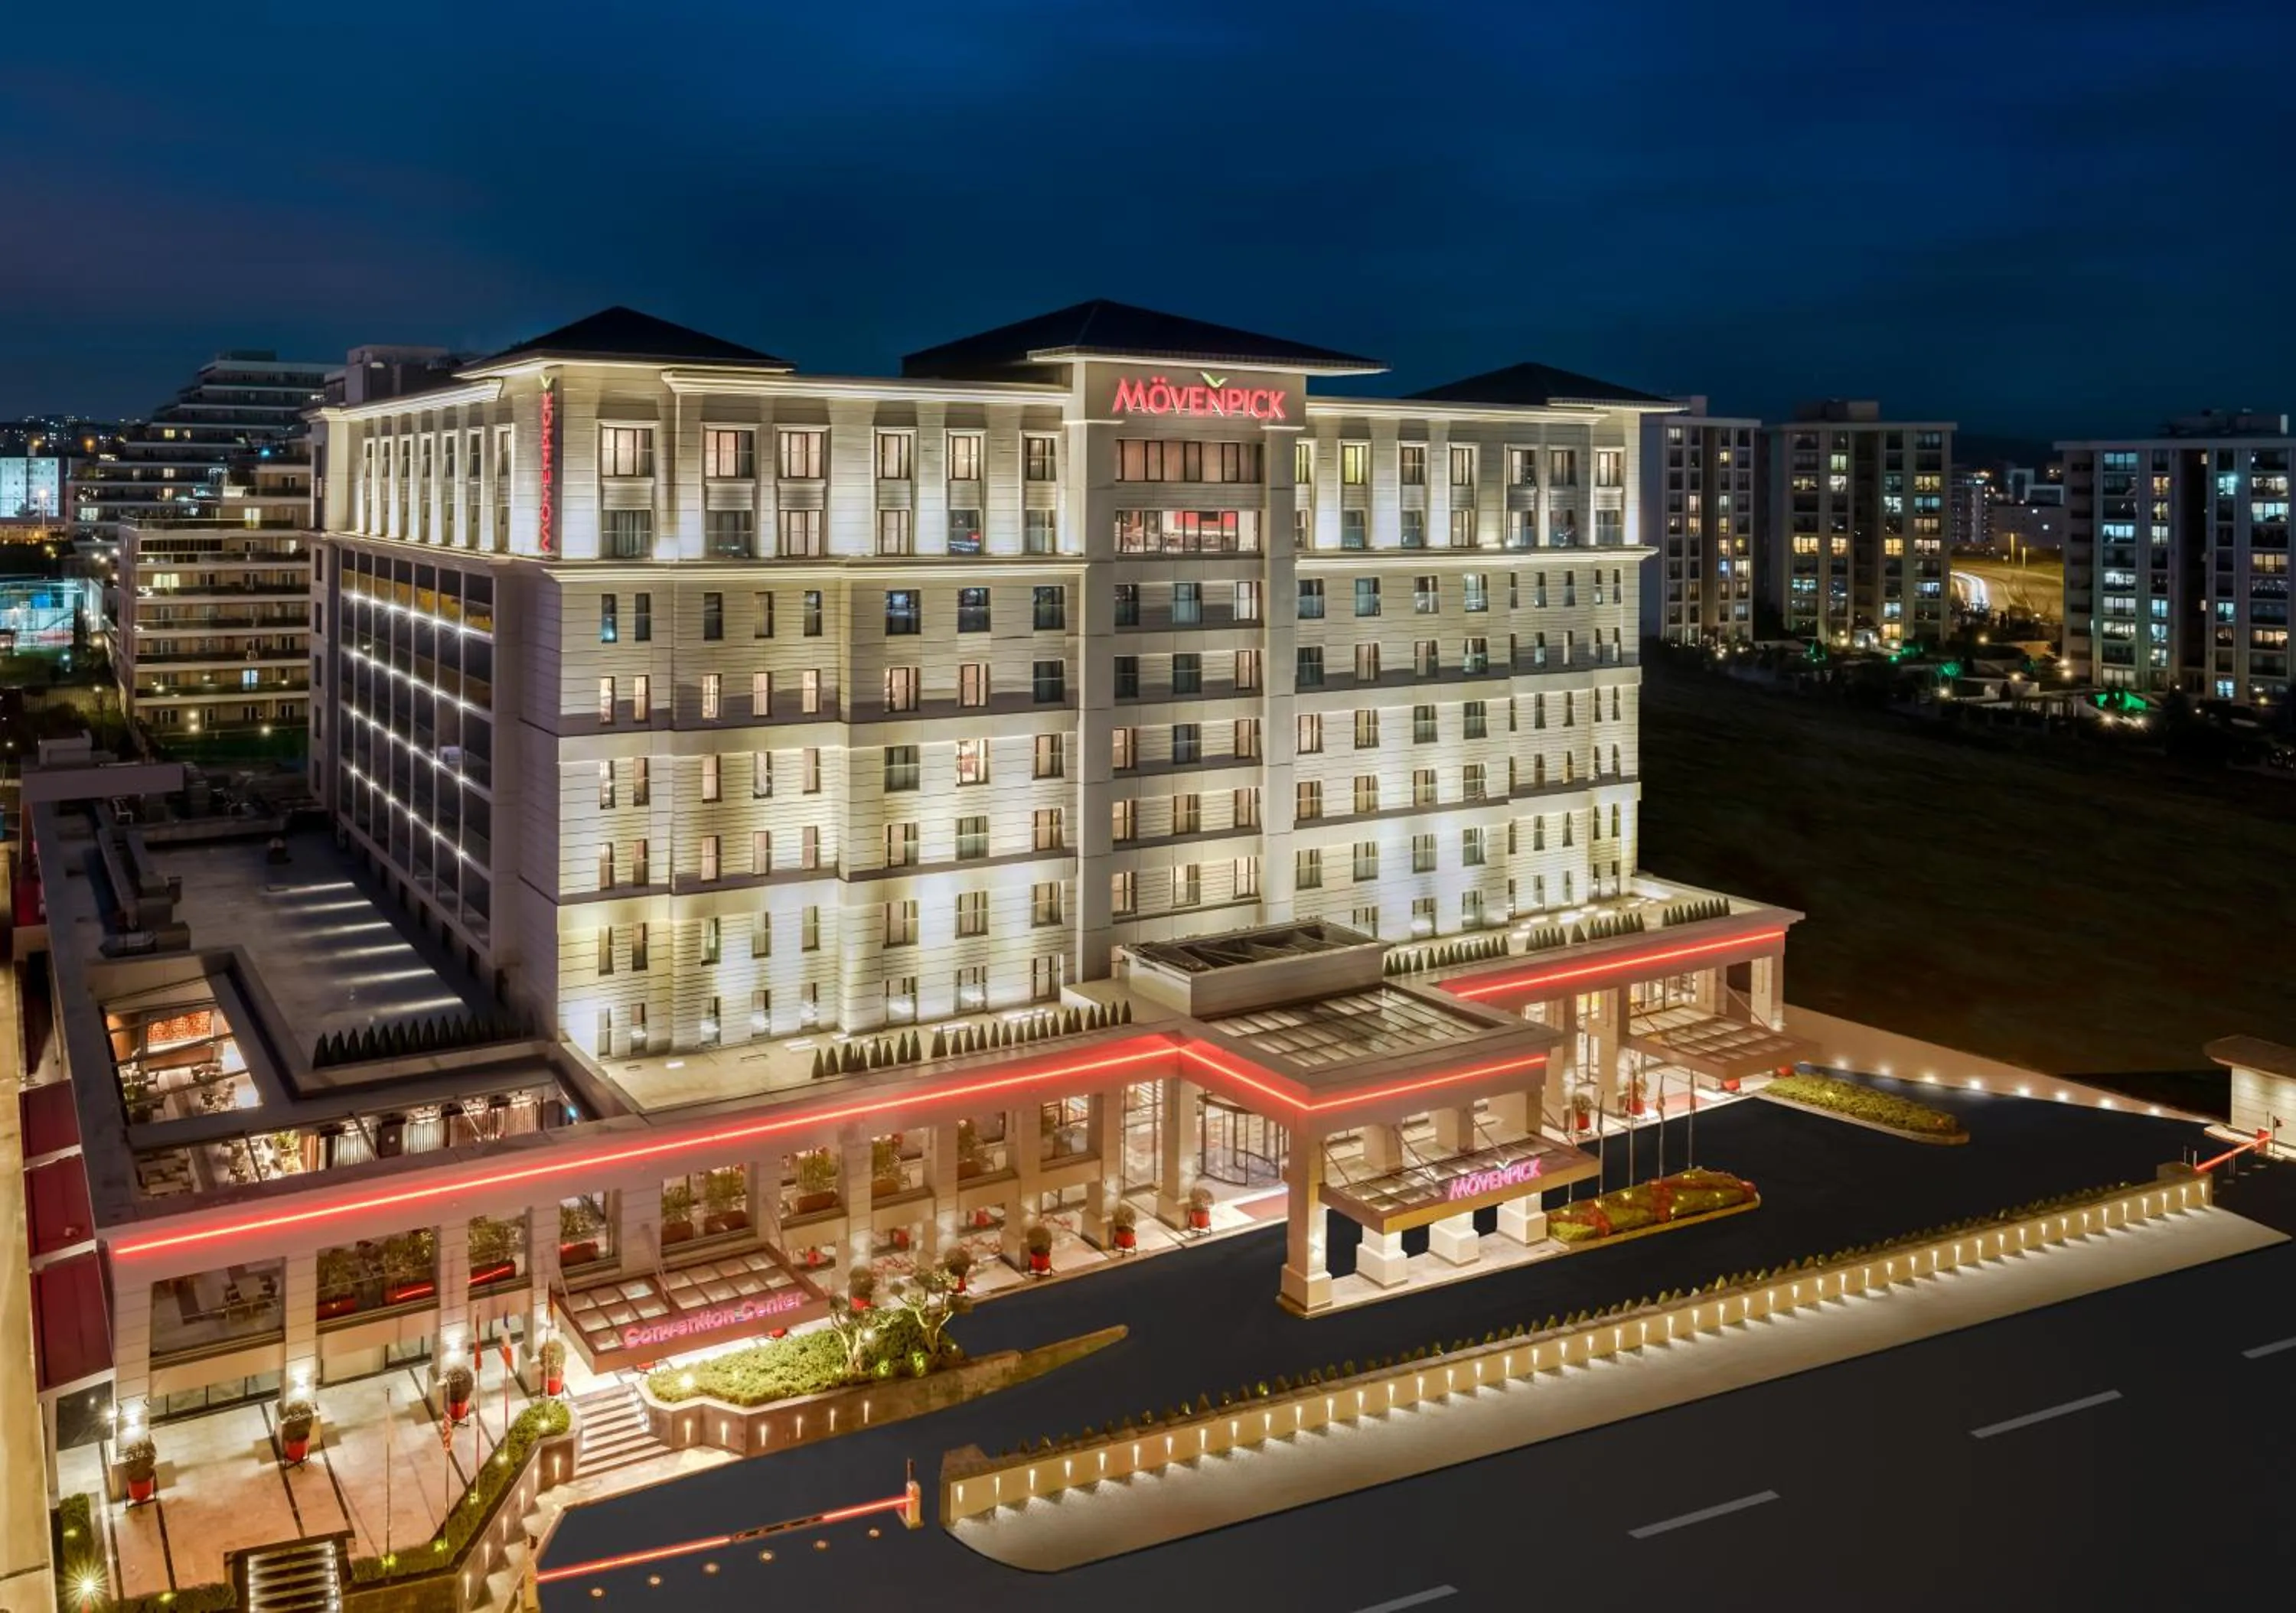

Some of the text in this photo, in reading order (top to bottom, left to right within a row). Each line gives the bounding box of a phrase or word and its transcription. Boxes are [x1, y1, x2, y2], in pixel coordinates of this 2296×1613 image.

[1112, 376, 1287, 419] MÖVENPICK
[1450, 1157, 1541, 1201] MÖVENPICK
[624, 1292, 802, 1349] Convention Center
